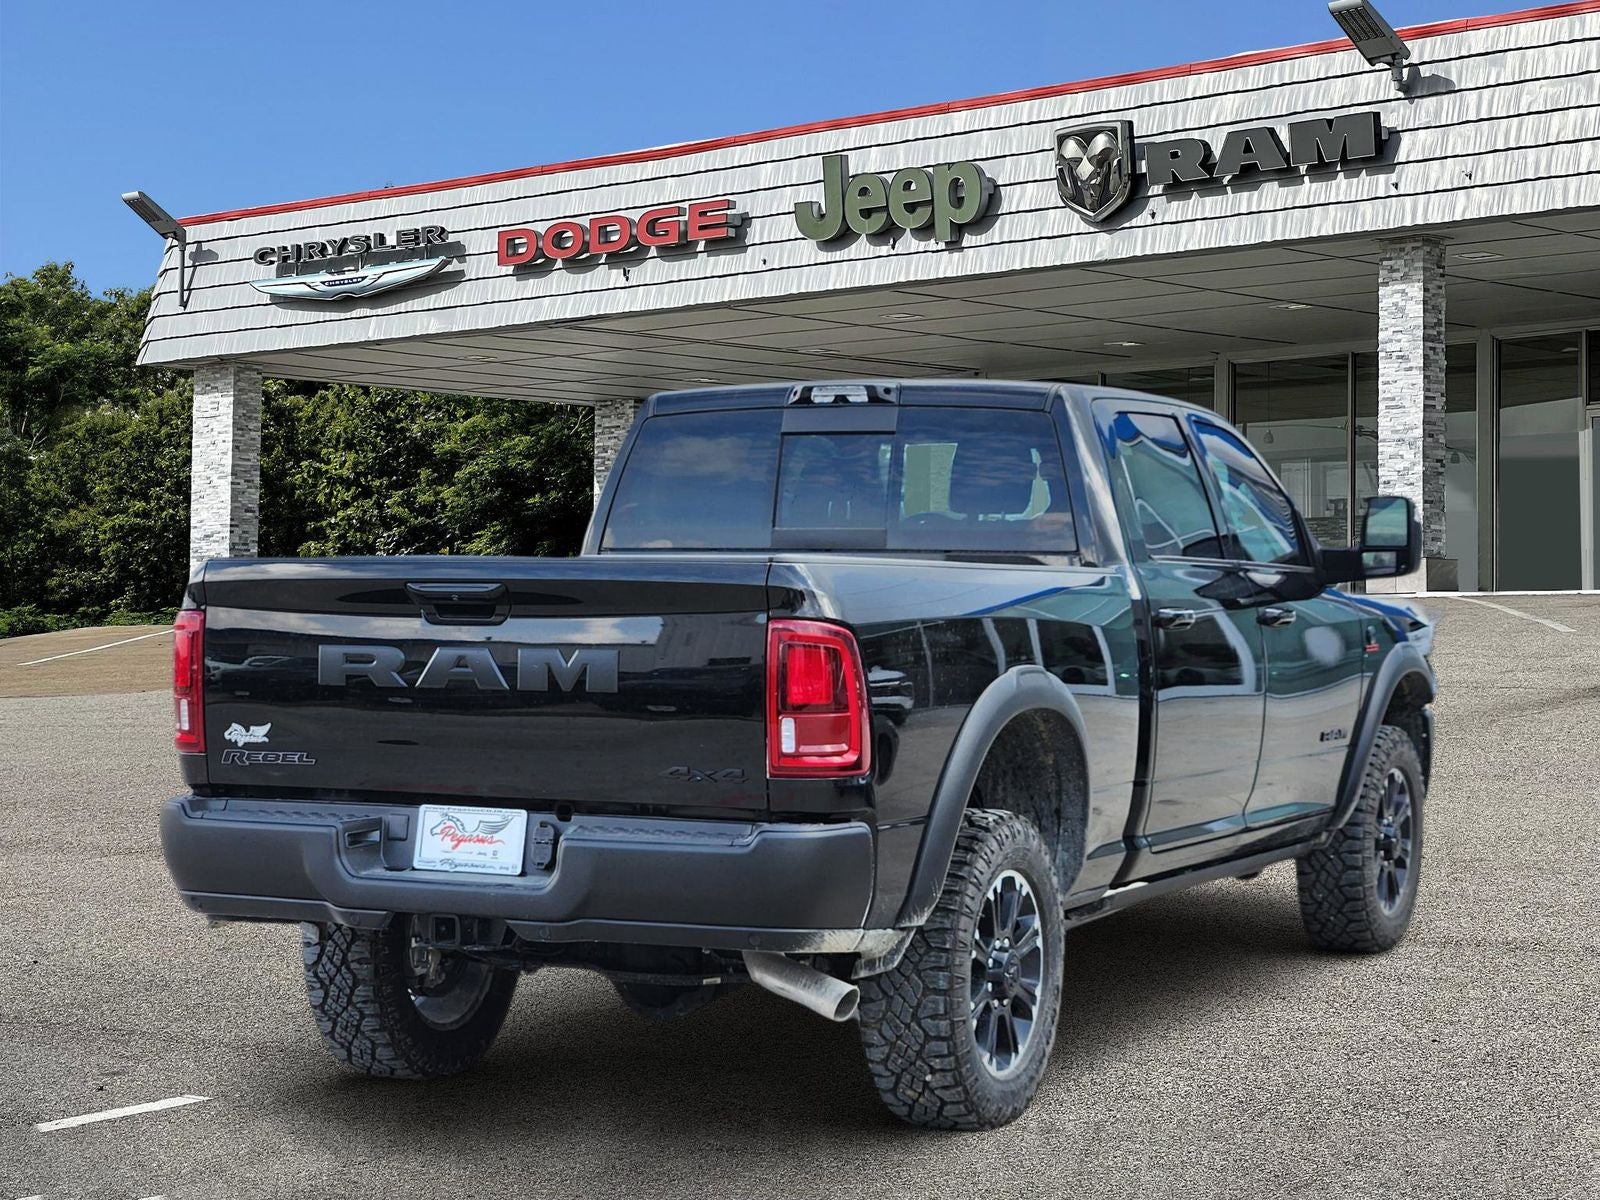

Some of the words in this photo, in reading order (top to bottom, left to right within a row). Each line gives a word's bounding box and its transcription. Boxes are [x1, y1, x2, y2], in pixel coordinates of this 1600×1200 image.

[1144, 112, 1380, 187] RAM
[794, 154, 989, 242] Jeep
[253, 225, 449, 266] CHRYSLER
[497, 199, 735, 266] DODGE
[324, 277, 363, 286] CHRYSLER
[318, 644, 619, 693] RAM
[221, 749, 316, 765] REBEL
[440, 825, 505, 849] Pegasus
